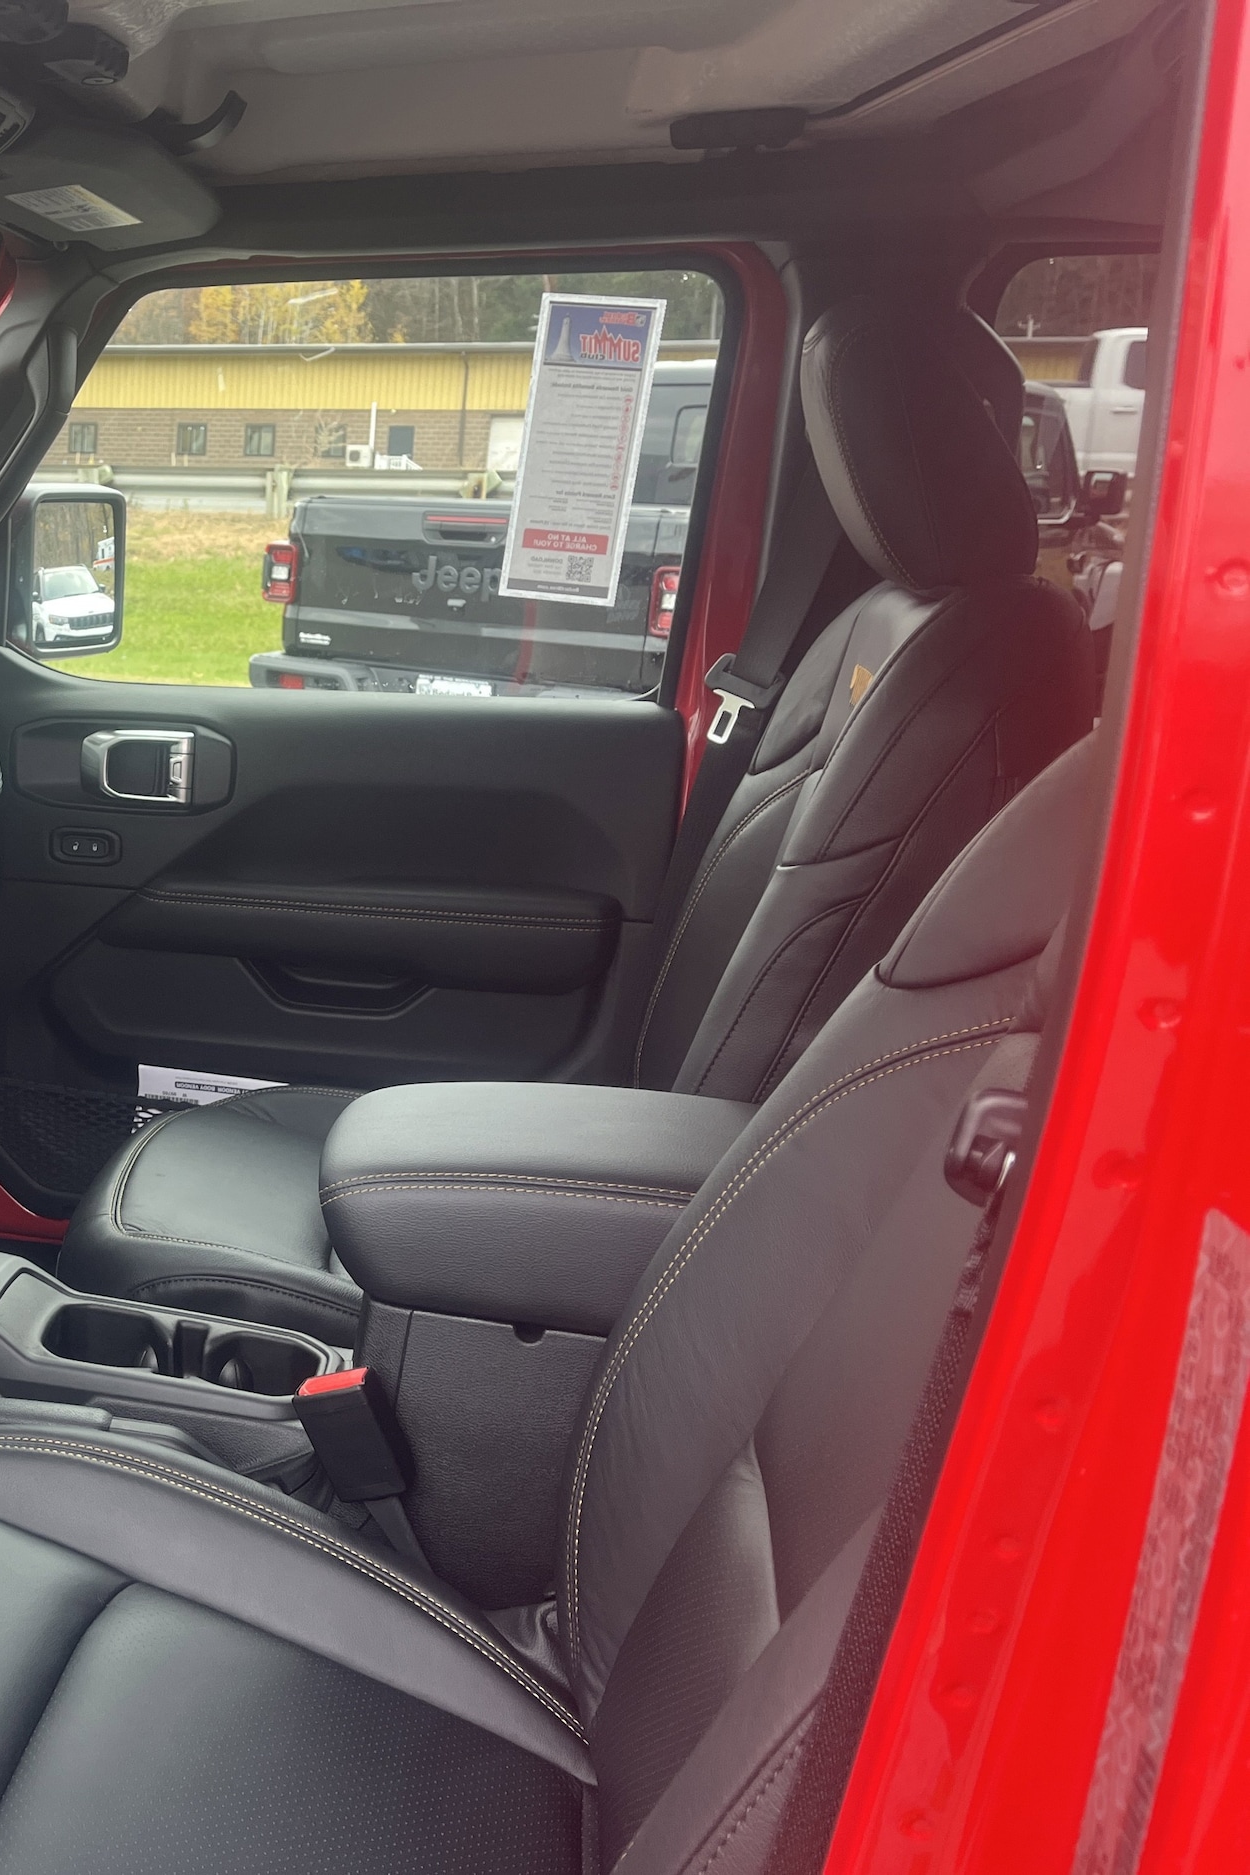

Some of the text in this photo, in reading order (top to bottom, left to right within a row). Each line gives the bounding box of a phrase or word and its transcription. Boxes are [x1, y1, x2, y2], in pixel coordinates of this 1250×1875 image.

[412, 555, 501, 602] Jeep
[175, 1081, 200, 1090] VENDOR
[199, 1084, 216, 1093] BODY
[217, 1086, 241, 1095] VENDOR
